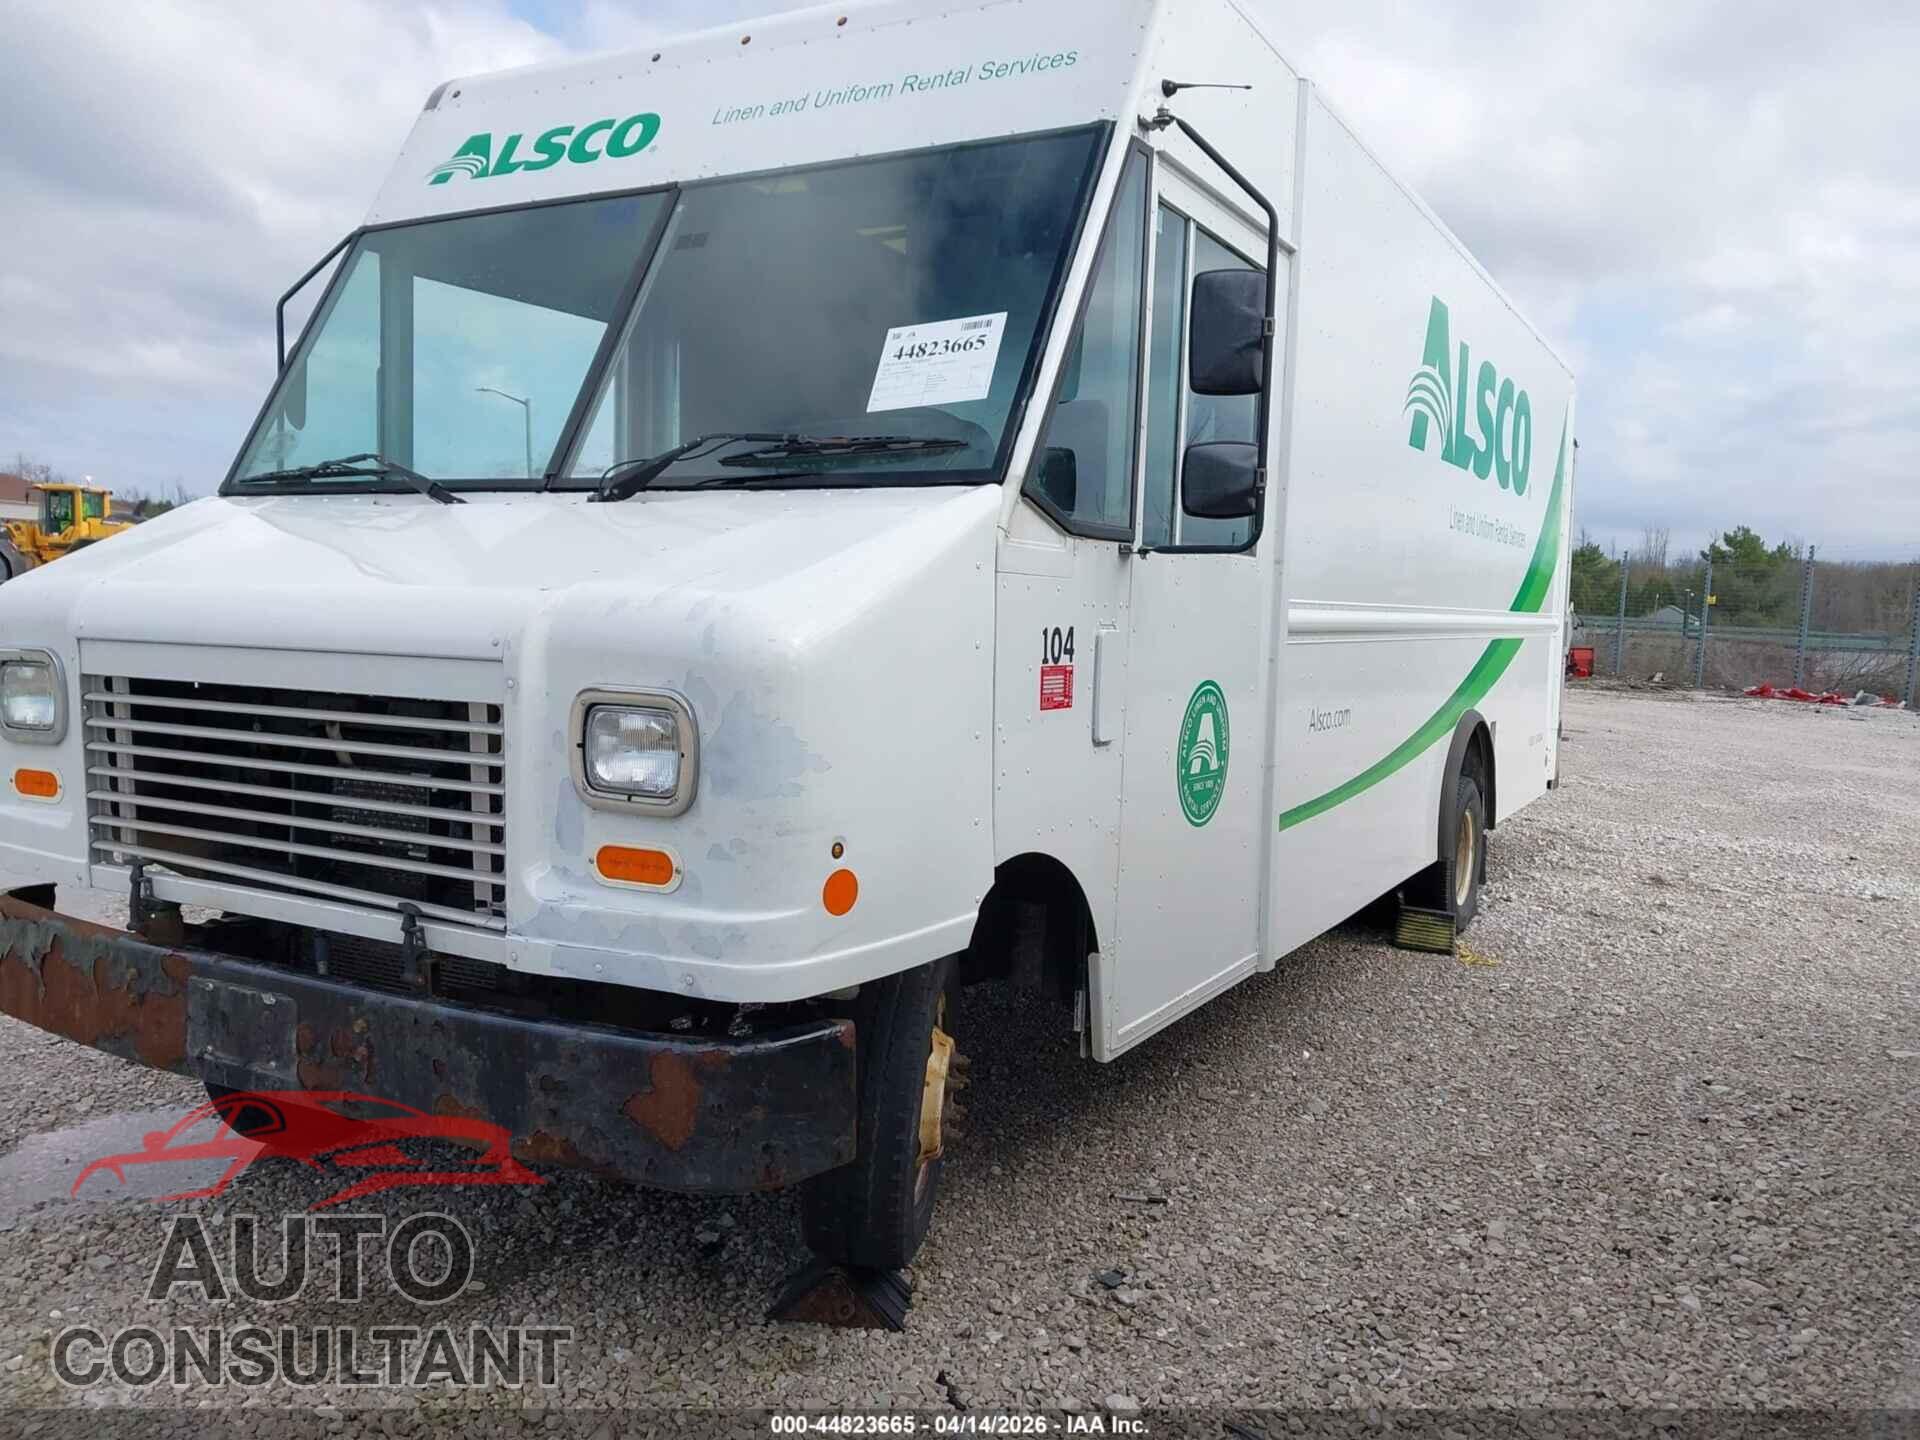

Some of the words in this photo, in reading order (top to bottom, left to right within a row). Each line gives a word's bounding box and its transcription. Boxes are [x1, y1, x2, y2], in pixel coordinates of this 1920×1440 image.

[711, 104, 765, 125] Linen
[769, 93, 810, 116] and
[814, 82, 895, 109] Uniform
[900, 64, 973, 95] Rental
[978, 50, 1079, 81] Services
[427, 112, 661, 185] ALSCO
[893, 334, 988, 360] 44823665
[1402, 294, 1532, 497] ALSCO
[1042, 626, 1075, 665] 104
[1308, 705, 1351, 732] Alsco.com
